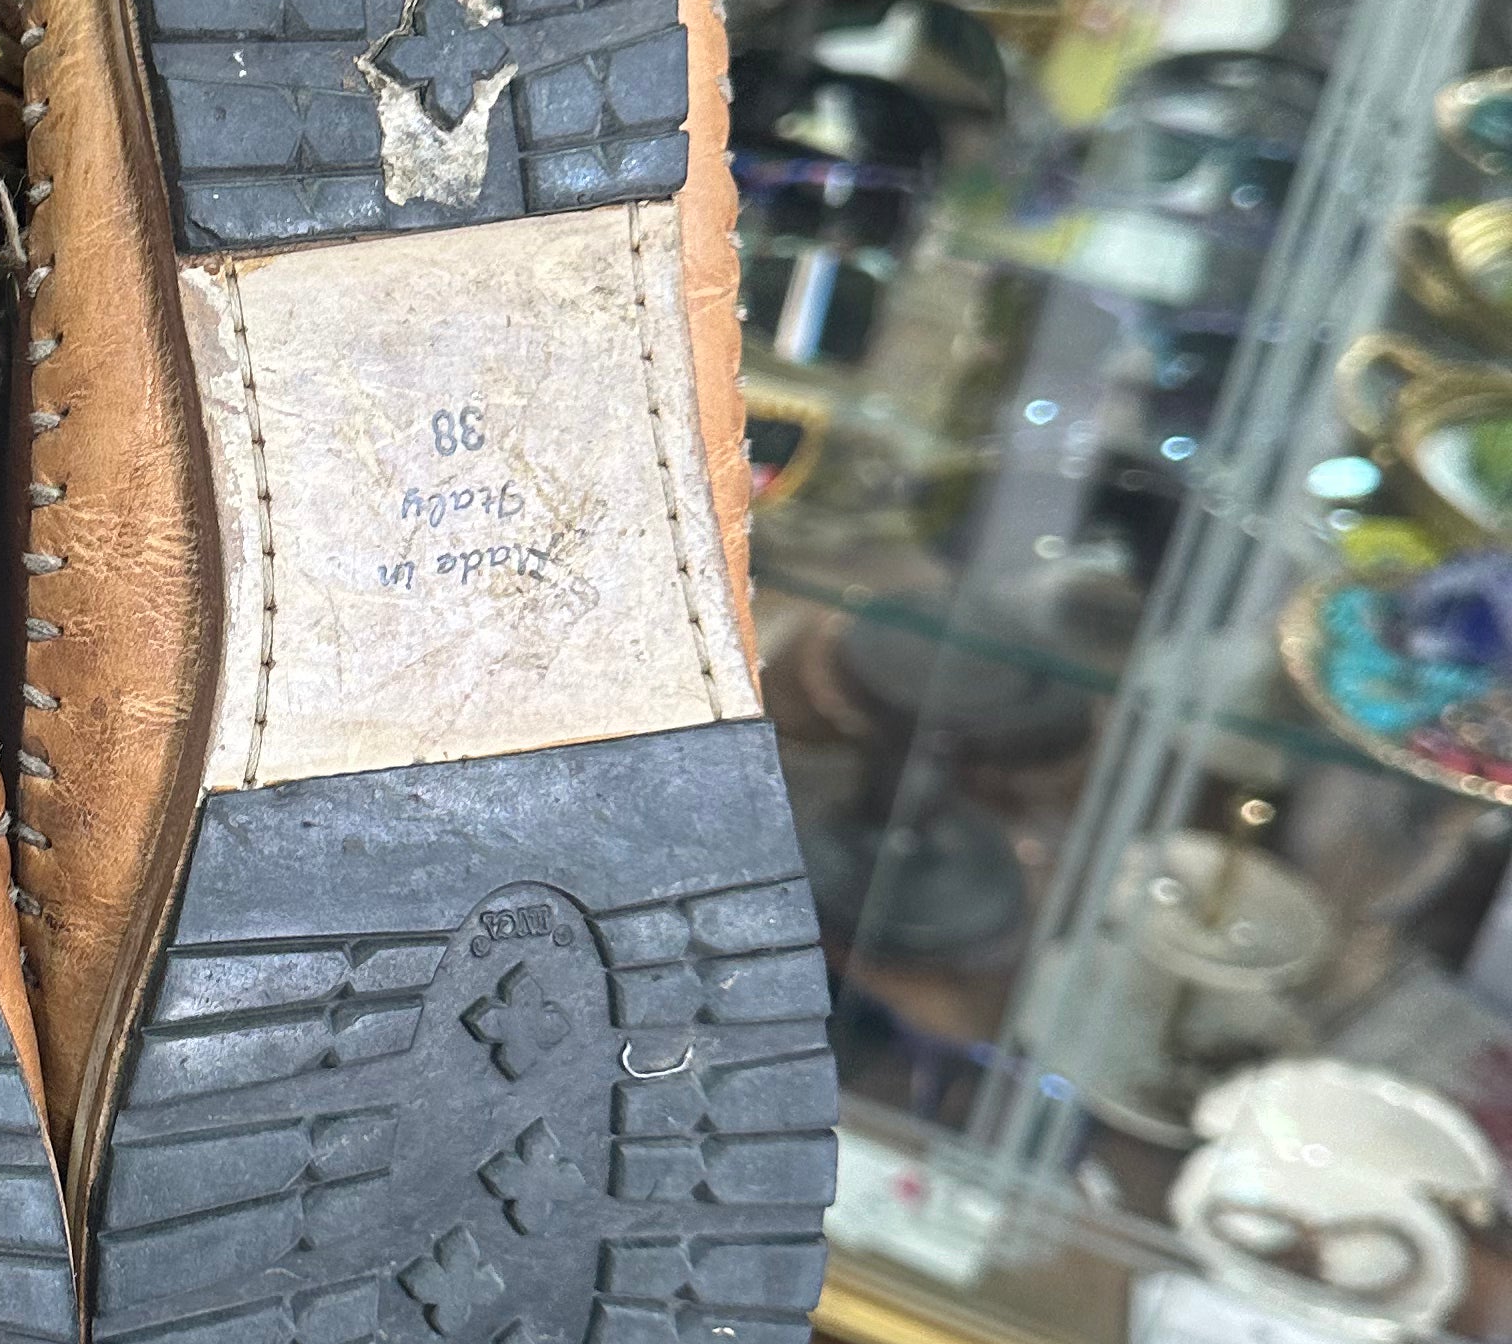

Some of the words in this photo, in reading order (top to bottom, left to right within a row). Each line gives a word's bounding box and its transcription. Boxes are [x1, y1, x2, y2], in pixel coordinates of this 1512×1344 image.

[431, 405, 486, 457] 38
[400, 478, 525, 528] Italy
[376, 560, 416, 591] in
